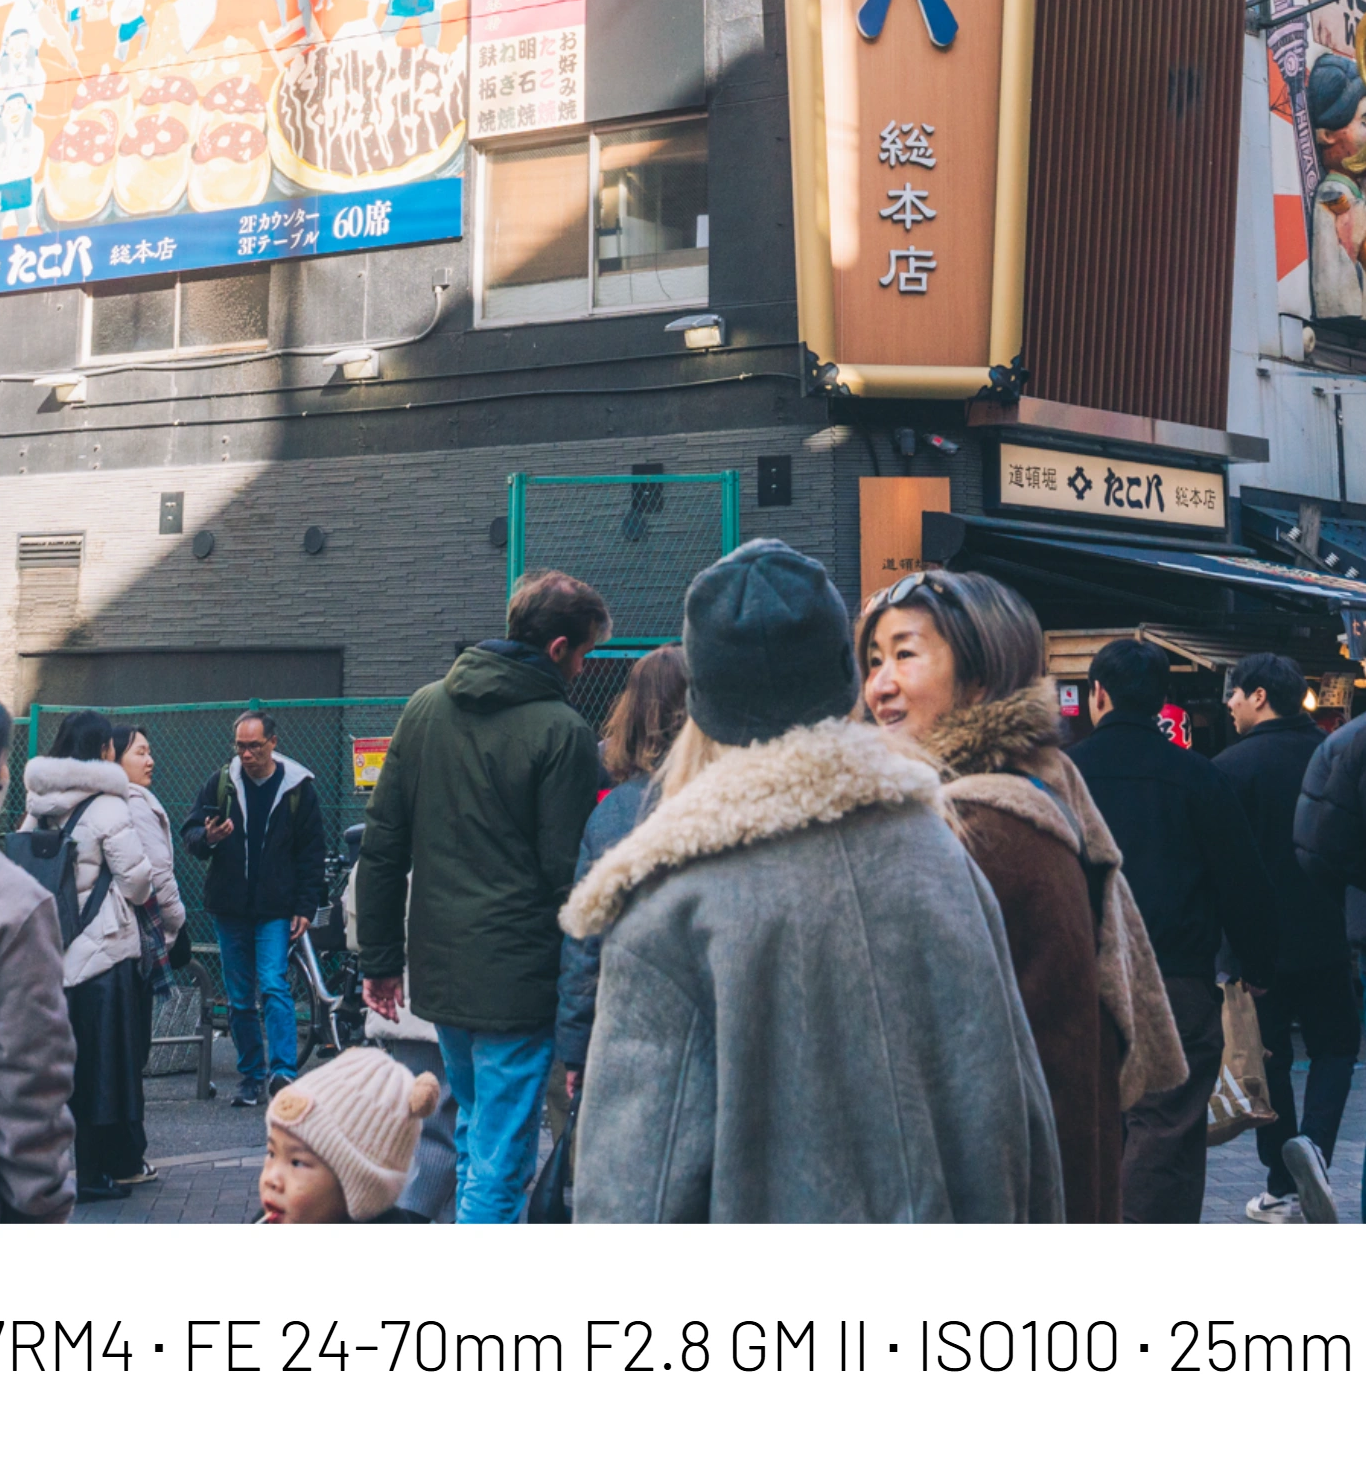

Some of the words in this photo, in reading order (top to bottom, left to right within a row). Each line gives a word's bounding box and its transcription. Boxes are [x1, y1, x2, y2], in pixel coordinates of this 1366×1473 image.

[477, 45, 498, 134] 鉄板焼
[497, 42, 518, 131] ねぎ焼
[517, 37, 537, 129] 明石焼
[537, 35, 557, 124] たこ焼
[557, 31, 578, 123] お好み焼
[878, 118, 939, 295] 総本店
[109, 237, 178, 267] 総本店
[1007, 464, 1058, 492] 道頓堀
[1174, 485, 1217, 511] 総本店
